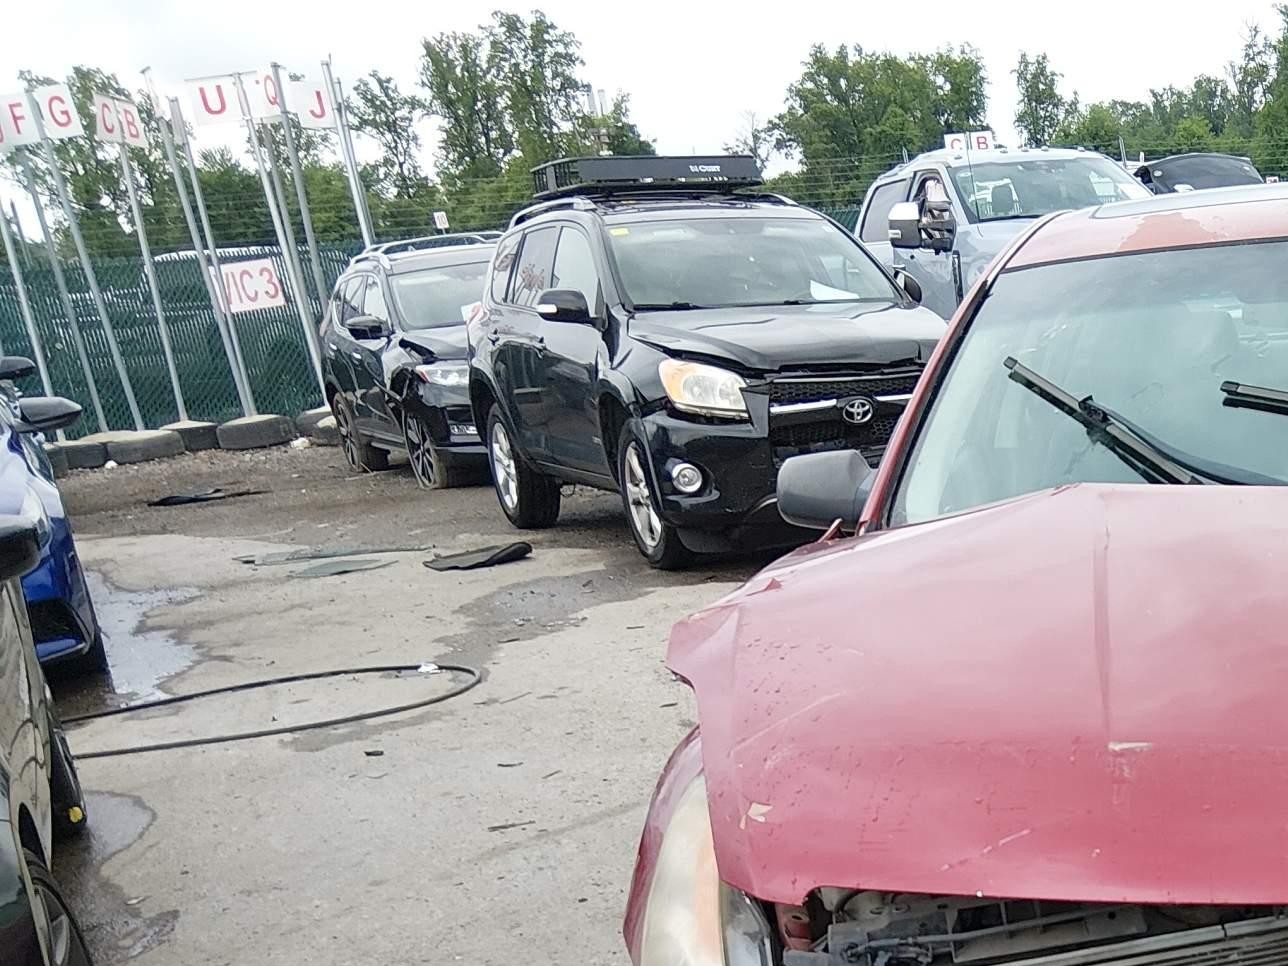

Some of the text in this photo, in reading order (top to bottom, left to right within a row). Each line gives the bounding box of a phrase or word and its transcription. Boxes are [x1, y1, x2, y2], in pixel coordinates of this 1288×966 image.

[47, 95, 73, 128] G
[198, 84, 226, 115] U
[309, 89, 326, 119] J
